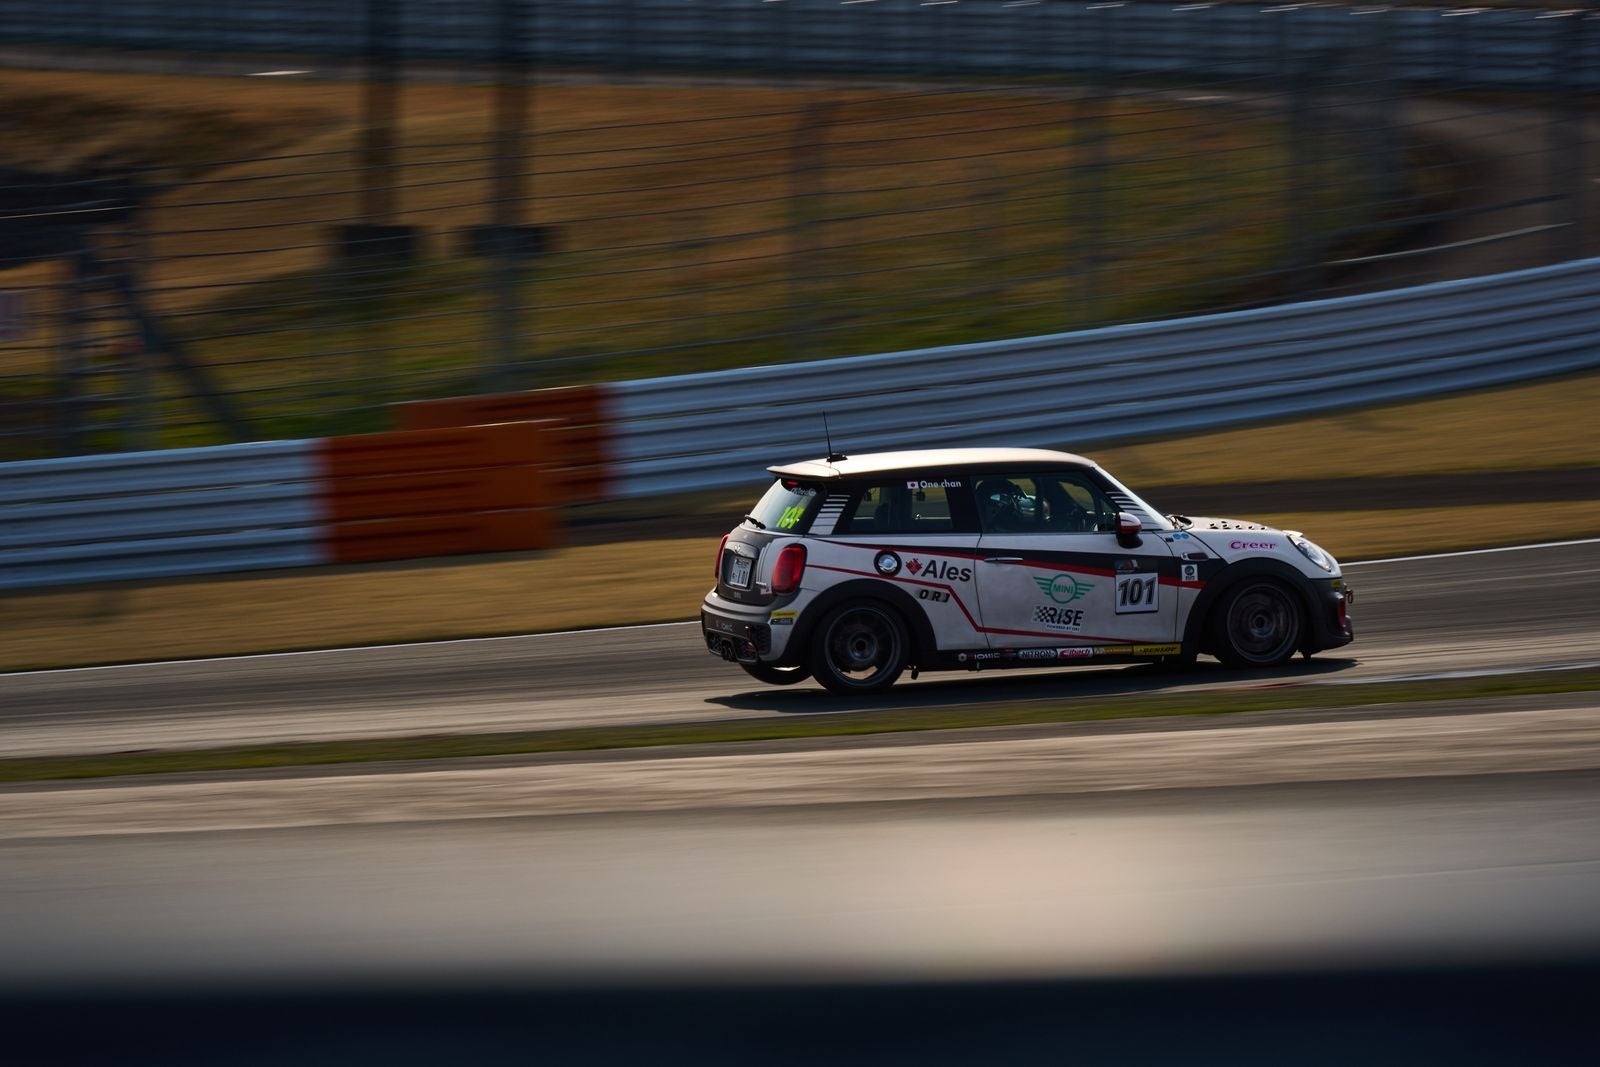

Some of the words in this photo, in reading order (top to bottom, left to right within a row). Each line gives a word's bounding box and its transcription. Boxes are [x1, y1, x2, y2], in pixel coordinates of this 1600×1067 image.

[920, 480, 938, 489] One
[940, 479, 962, 488] chan
[1229, 540, 1277, 551] Creer
[921, 560, 972, 582] Ales
[1053, 584, 1074, 595] MINI
[1118, 577, 1157, 607] 101
[1046, 605, 1085, 627] RISE
